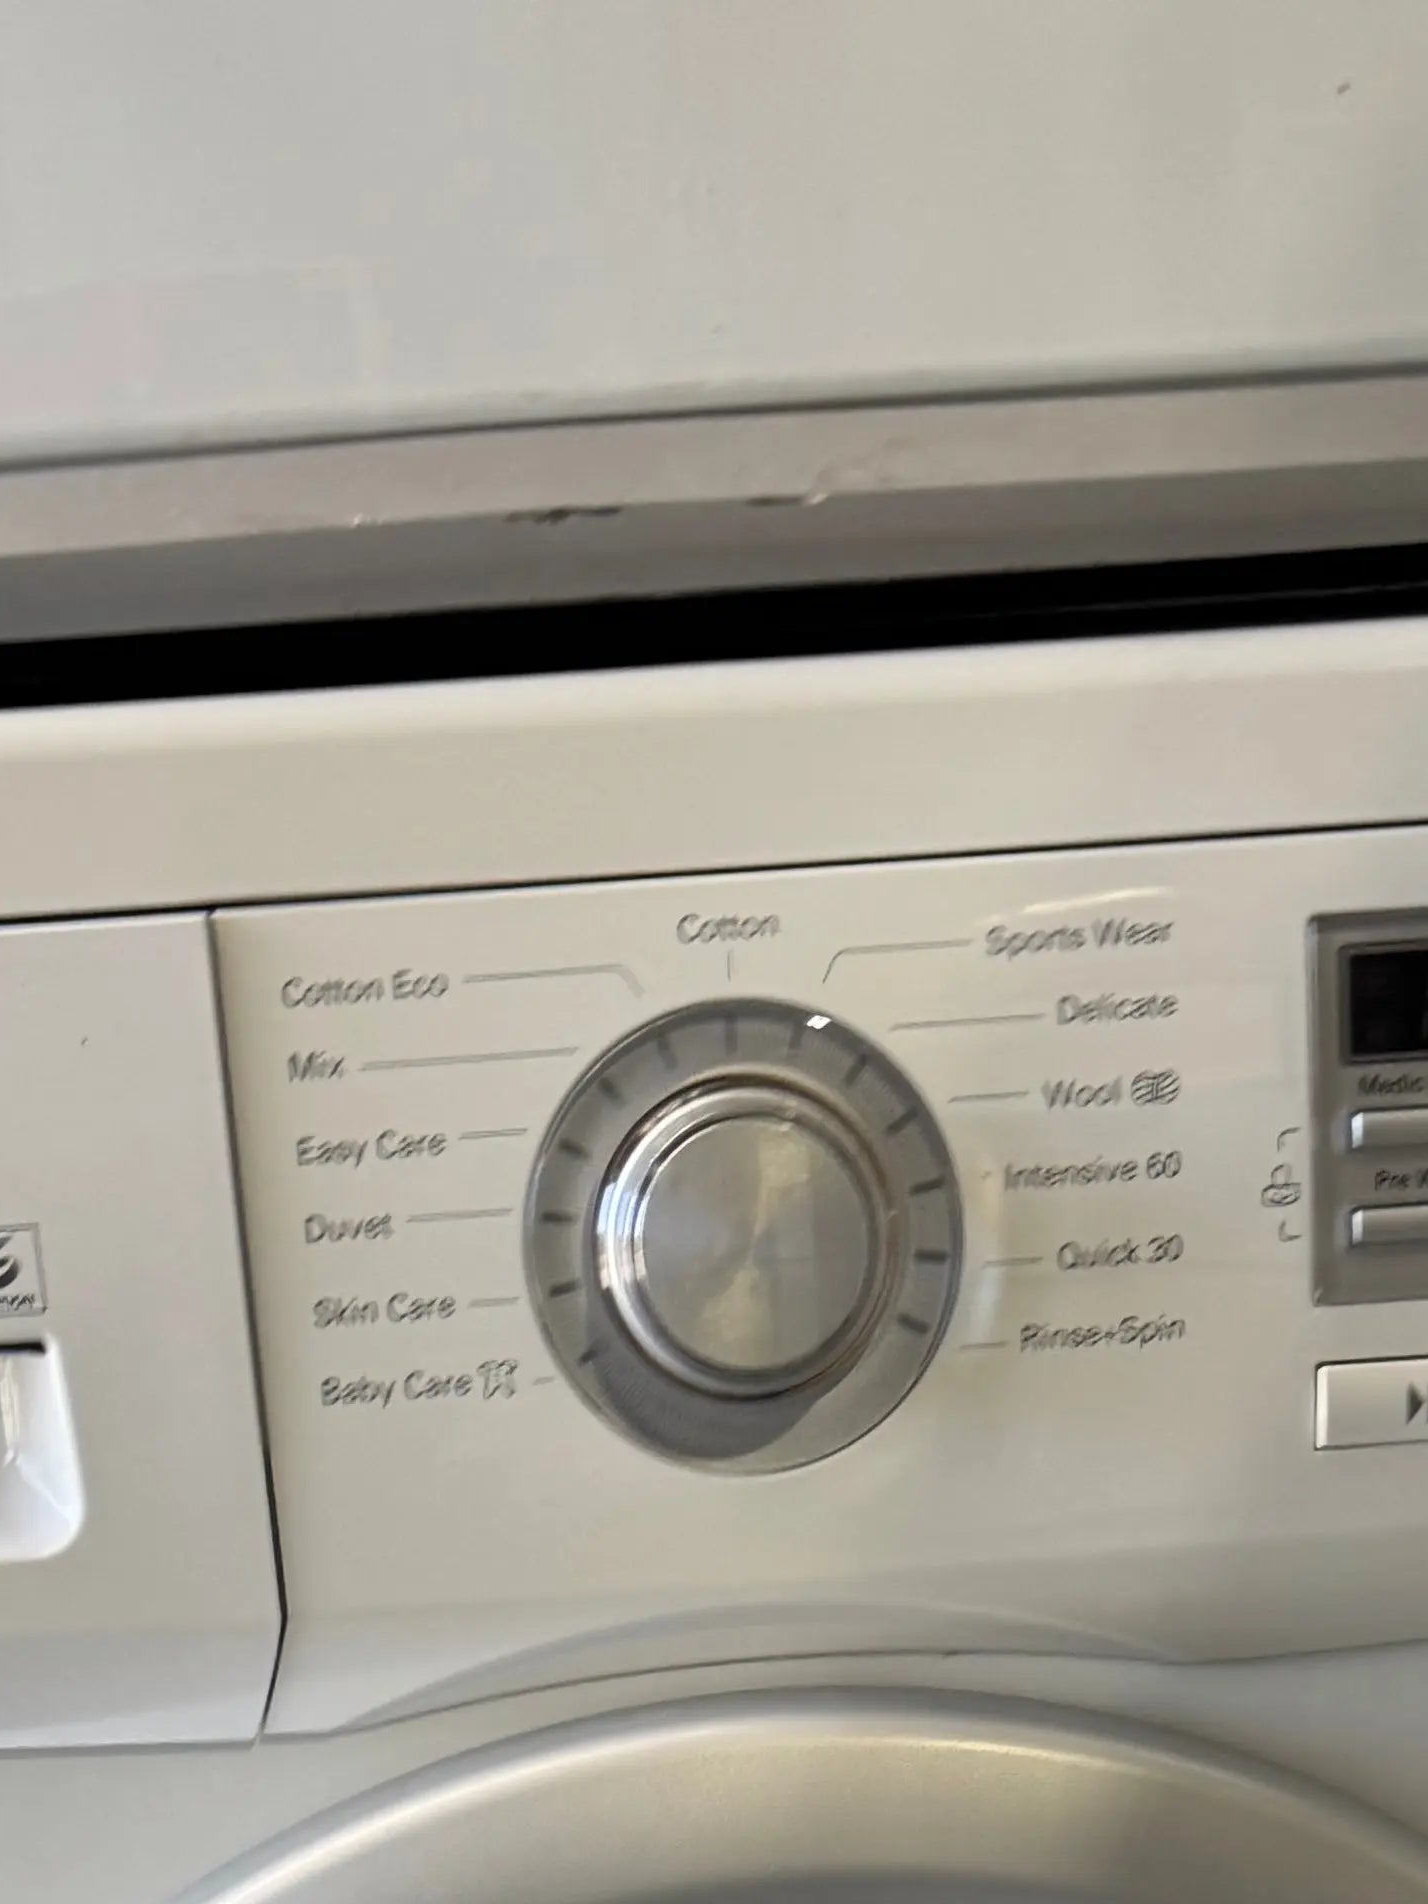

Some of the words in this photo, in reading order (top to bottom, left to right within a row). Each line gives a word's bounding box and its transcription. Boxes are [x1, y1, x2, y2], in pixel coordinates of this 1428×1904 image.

[676, 912, 781, 944] Cotton
[985, 924, 1087, 961] Sports
[1091, 917, 1174, 948] Wear
[281, 976, 385, 1008] Cotton
[392, 969, 450, 1000] Eco
[1057, 993, 1179, 1025] Delicate
[287, 1050, 346, 1083] Mix
[1041, 1075, 1123, 1111] Wool
[296, 1136, 368, 1168] Easy
[375, 1129, 447, 1160] Care
[1004, 1154, 1139, 1192] Intensive
[1146, 1150, 1183, 1180] 60
[304, 1213, 395, 1244] Duvet
[1057, 1238, 1140, 1271] Quick
[1146, 1233, 1185, 1264] 30
[313, 1296, 379, 1329] Skin
[386, 1291, 456, 1323] Care
[1020, 1312, 1186, 1354] Rinse+Spin
[321, 1375, 396, 1409] Baby
[403, 1369, 474, 1401] Care
